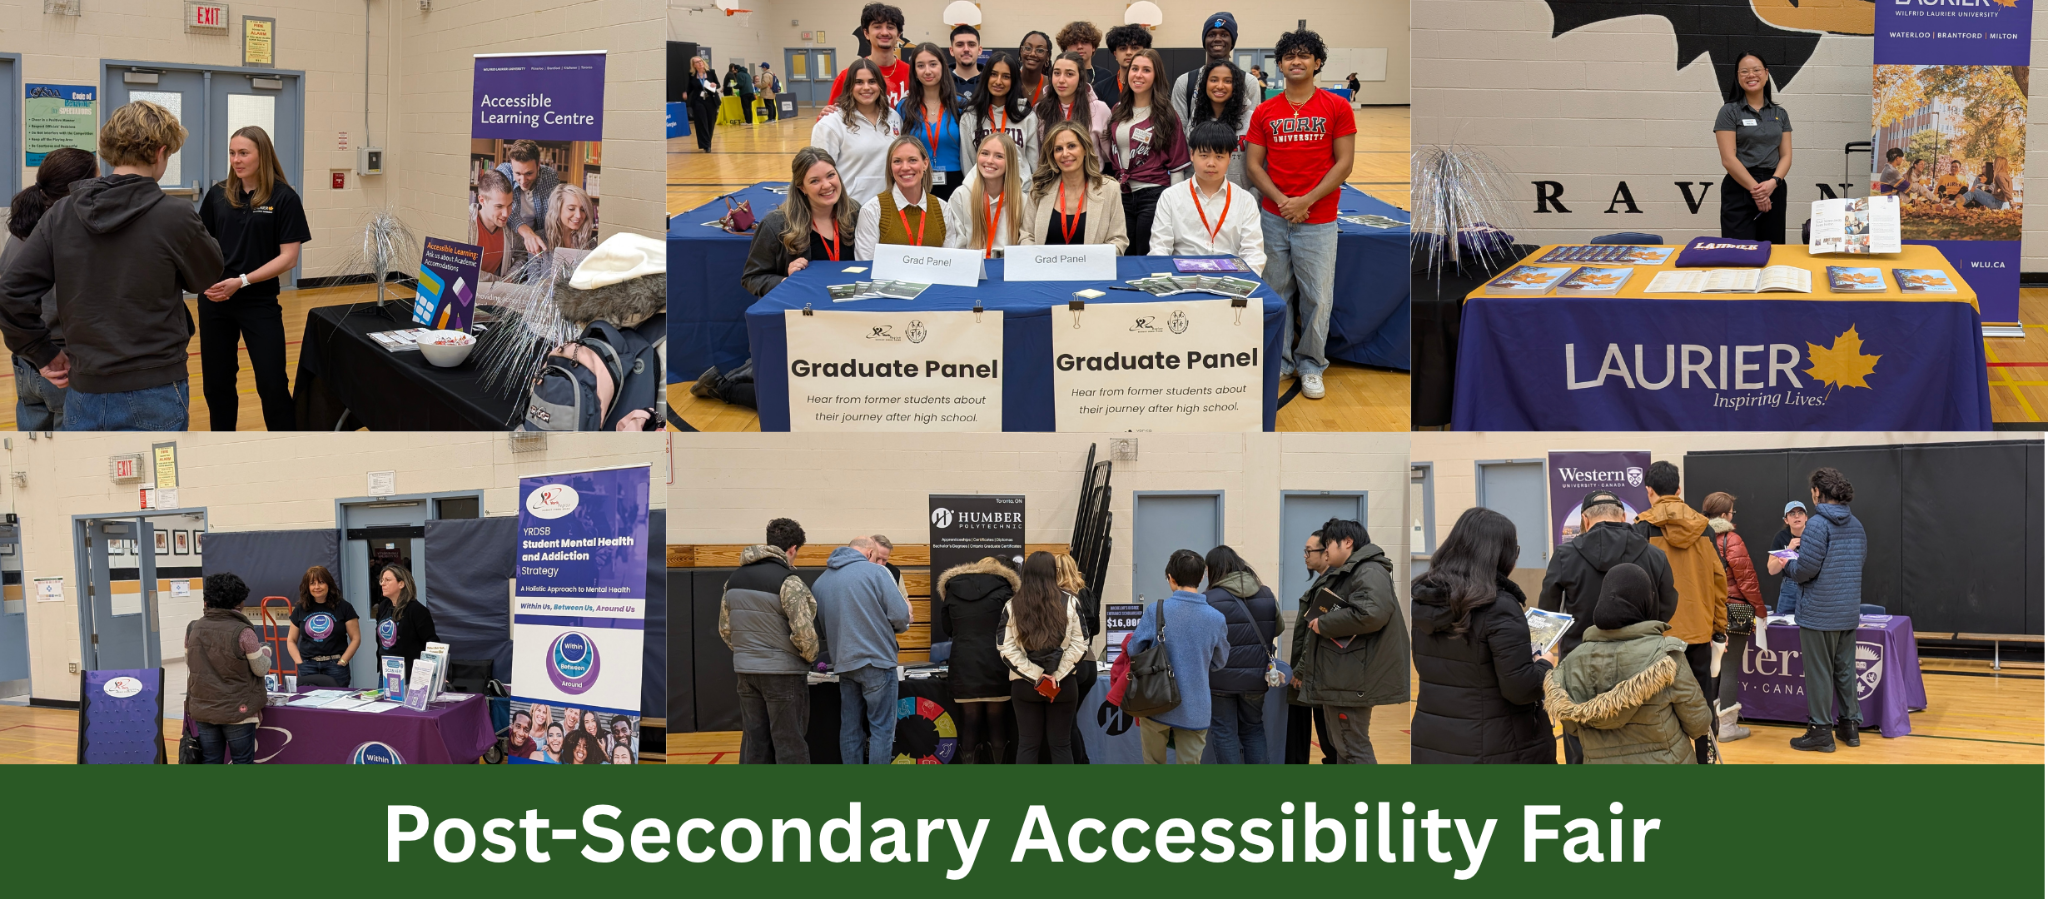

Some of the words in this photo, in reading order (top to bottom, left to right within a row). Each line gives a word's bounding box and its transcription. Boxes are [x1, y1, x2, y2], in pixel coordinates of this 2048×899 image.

[197, 6, 220, 25] EXIT
[1889, 31, 1931, 39] WATERLOO
[480, 93, 552, 108] Accessible
[480, 110, 540, 129] Learning
[543, 110, 595, 125] Centre
[1269, 116, 1327, 135] YORK
[1273, 133, 1325, 143] UNIVERSITY
[426, 242, 454, 254] Accessible
[453, 248, 479, 260] Learning:
[425, 250, 435, 258] Ask
[440, 253, 454, 263] about
[454, 256, 478, 268] Academic
[902, 254, 924, 266] Grad
[926, 256, 952, 267] Panel
[1034, 254, 1058, 264] Grad
[1060, 254, 1087, 263] Panel
[1970, 261, 2006, 269] WLU.CA
[423, 258, 460, 273] Accomodations
[1056, 351, 1181, 372] Graduate
[1187, 347, 1258, 370] Panel
[791, 358, 919, 378] Graduate
[925, 359, 998, 379] Panel
[1565, 343, 1804, 390] LAURIER
[1071, 388, 1097, 397] Hear
[1099, 387, 1125, 397] from
[1127, 386, 1163, 396] former
[1166, 386, 1213, 396] students
[1215, 385, 1248, 395] about
[807, 394, 833, 404] Hear
[835, 394, 861, 404] from
[864, 394, 901, 404] former
[904, 395, 950, 405] students
[953, 395, 986, 405] about
[1713, 390, 1782, 411] Inspiring
[1785, 390, 1826, 406] Lives.
[1079, 405, 1103, 414] their
[1104, 405, 1145, 416] journey
[1148, 404, 1174, 413] after
[1176, 403, 1200, 415] high
[1202, 403, 1239, 413] school.
[815, 412, 839, 421] their
[841, 412, 883, 424] journey
[885, 412, 911, 422] after
[913, 413, 938, 424] high
[940, 413, 978, 422] school.
[116, 460, 133, 477] EXIT
[1558, 467, 1625, 482] Western
[958, 511, 1022, 523] HUMBER
[523, 526, 551, 537] YRDSB
[522, 539, 560, 549] Student
[561, 537, 597, 548] Mental
[598, 536, 635, 546] Health
[522, 552, 540, 562] and
[541, 550, 590, 561] Addiction
[521, 566, 559, 578] Strategy
[547, 586, 577, 594] Approach
[608, 586, 631, 594] Health
[520, 602, 542, 610] Within
[542, 603, 552, 611] Us,
[584, 604, 595, 612] Us,
[595, 605, 625, 613] Around
[625, 605, 636, 613] Us
[564, 643, 583, 651] Within
[560, 663, 585, 671] Between
[561, 680, 583, 688] Around
[1762, 683, 1805, 696] CANA
[366, 754, 389, 764] Within
